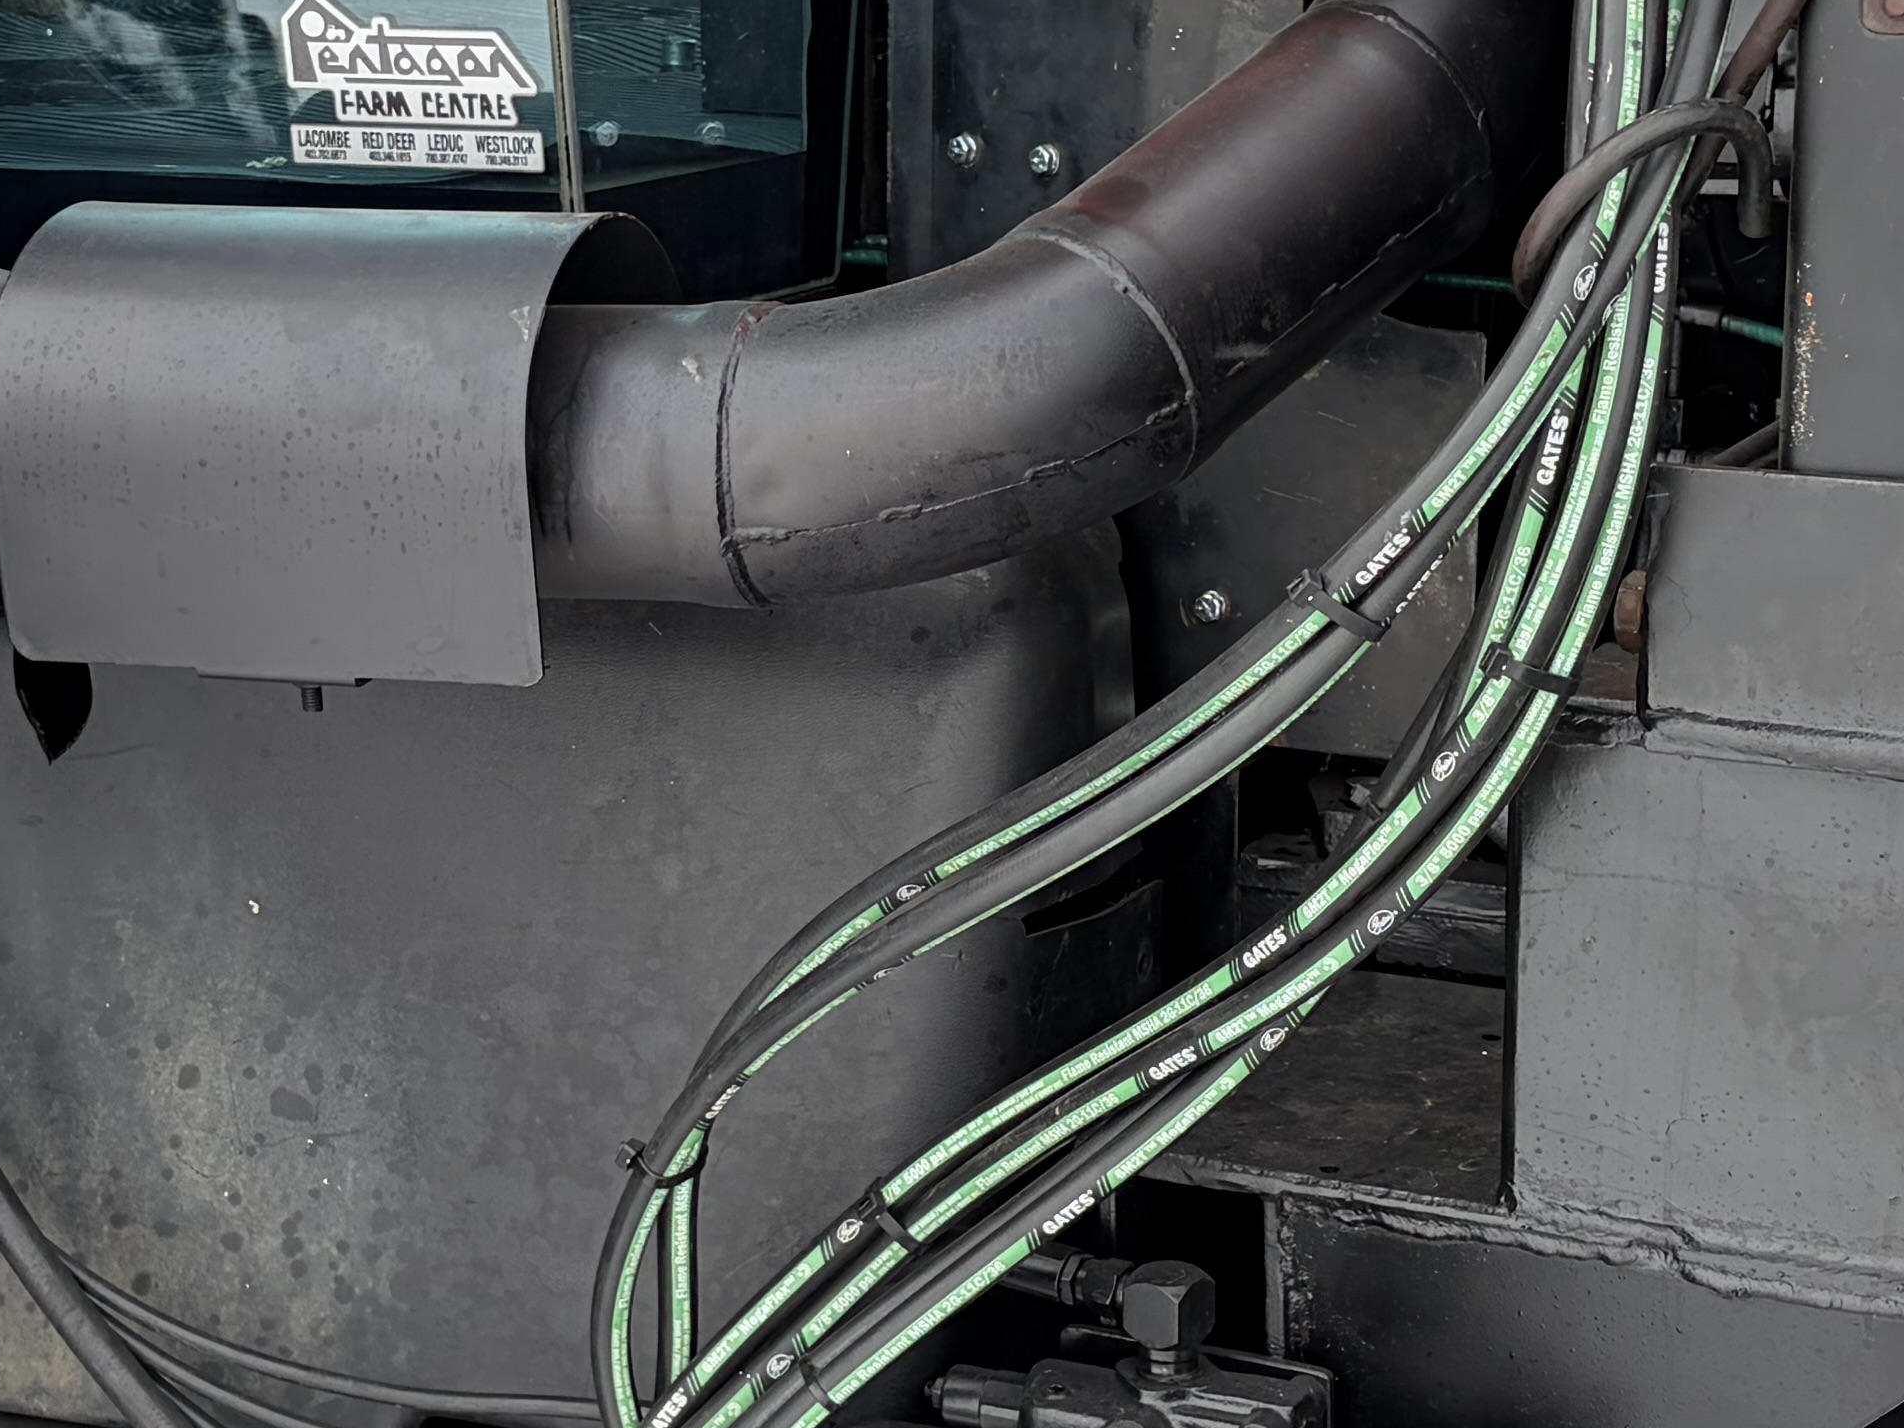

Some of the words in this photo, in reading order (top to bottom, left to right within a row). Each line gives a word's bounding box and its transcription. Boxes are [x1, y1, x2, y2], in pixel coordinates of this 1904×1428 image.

[341, 90, 412, 117] FARM
[422, 92, 511, 120] CENTRE
[298, 129, 351, 149] LACOMBE
[363, 131, 385, 150] RED
[388, 132, 416, 151] DEER
[428, 133, 464, 152] LEDUC
[475, 134, 536, 154] WESTLOCK
[1592, 375, 1613, 424] Flame
[1536, 409, 1569, 486] GATES
[1355, 530, 1412, 585] GATES
[1574, 579, 1603, 629] Flame
[1242, 925, 1287, 969] GATES
[1147, 1045, 1196, 1081] GATES
[1042, 1190, 1095, 1235] GATES
